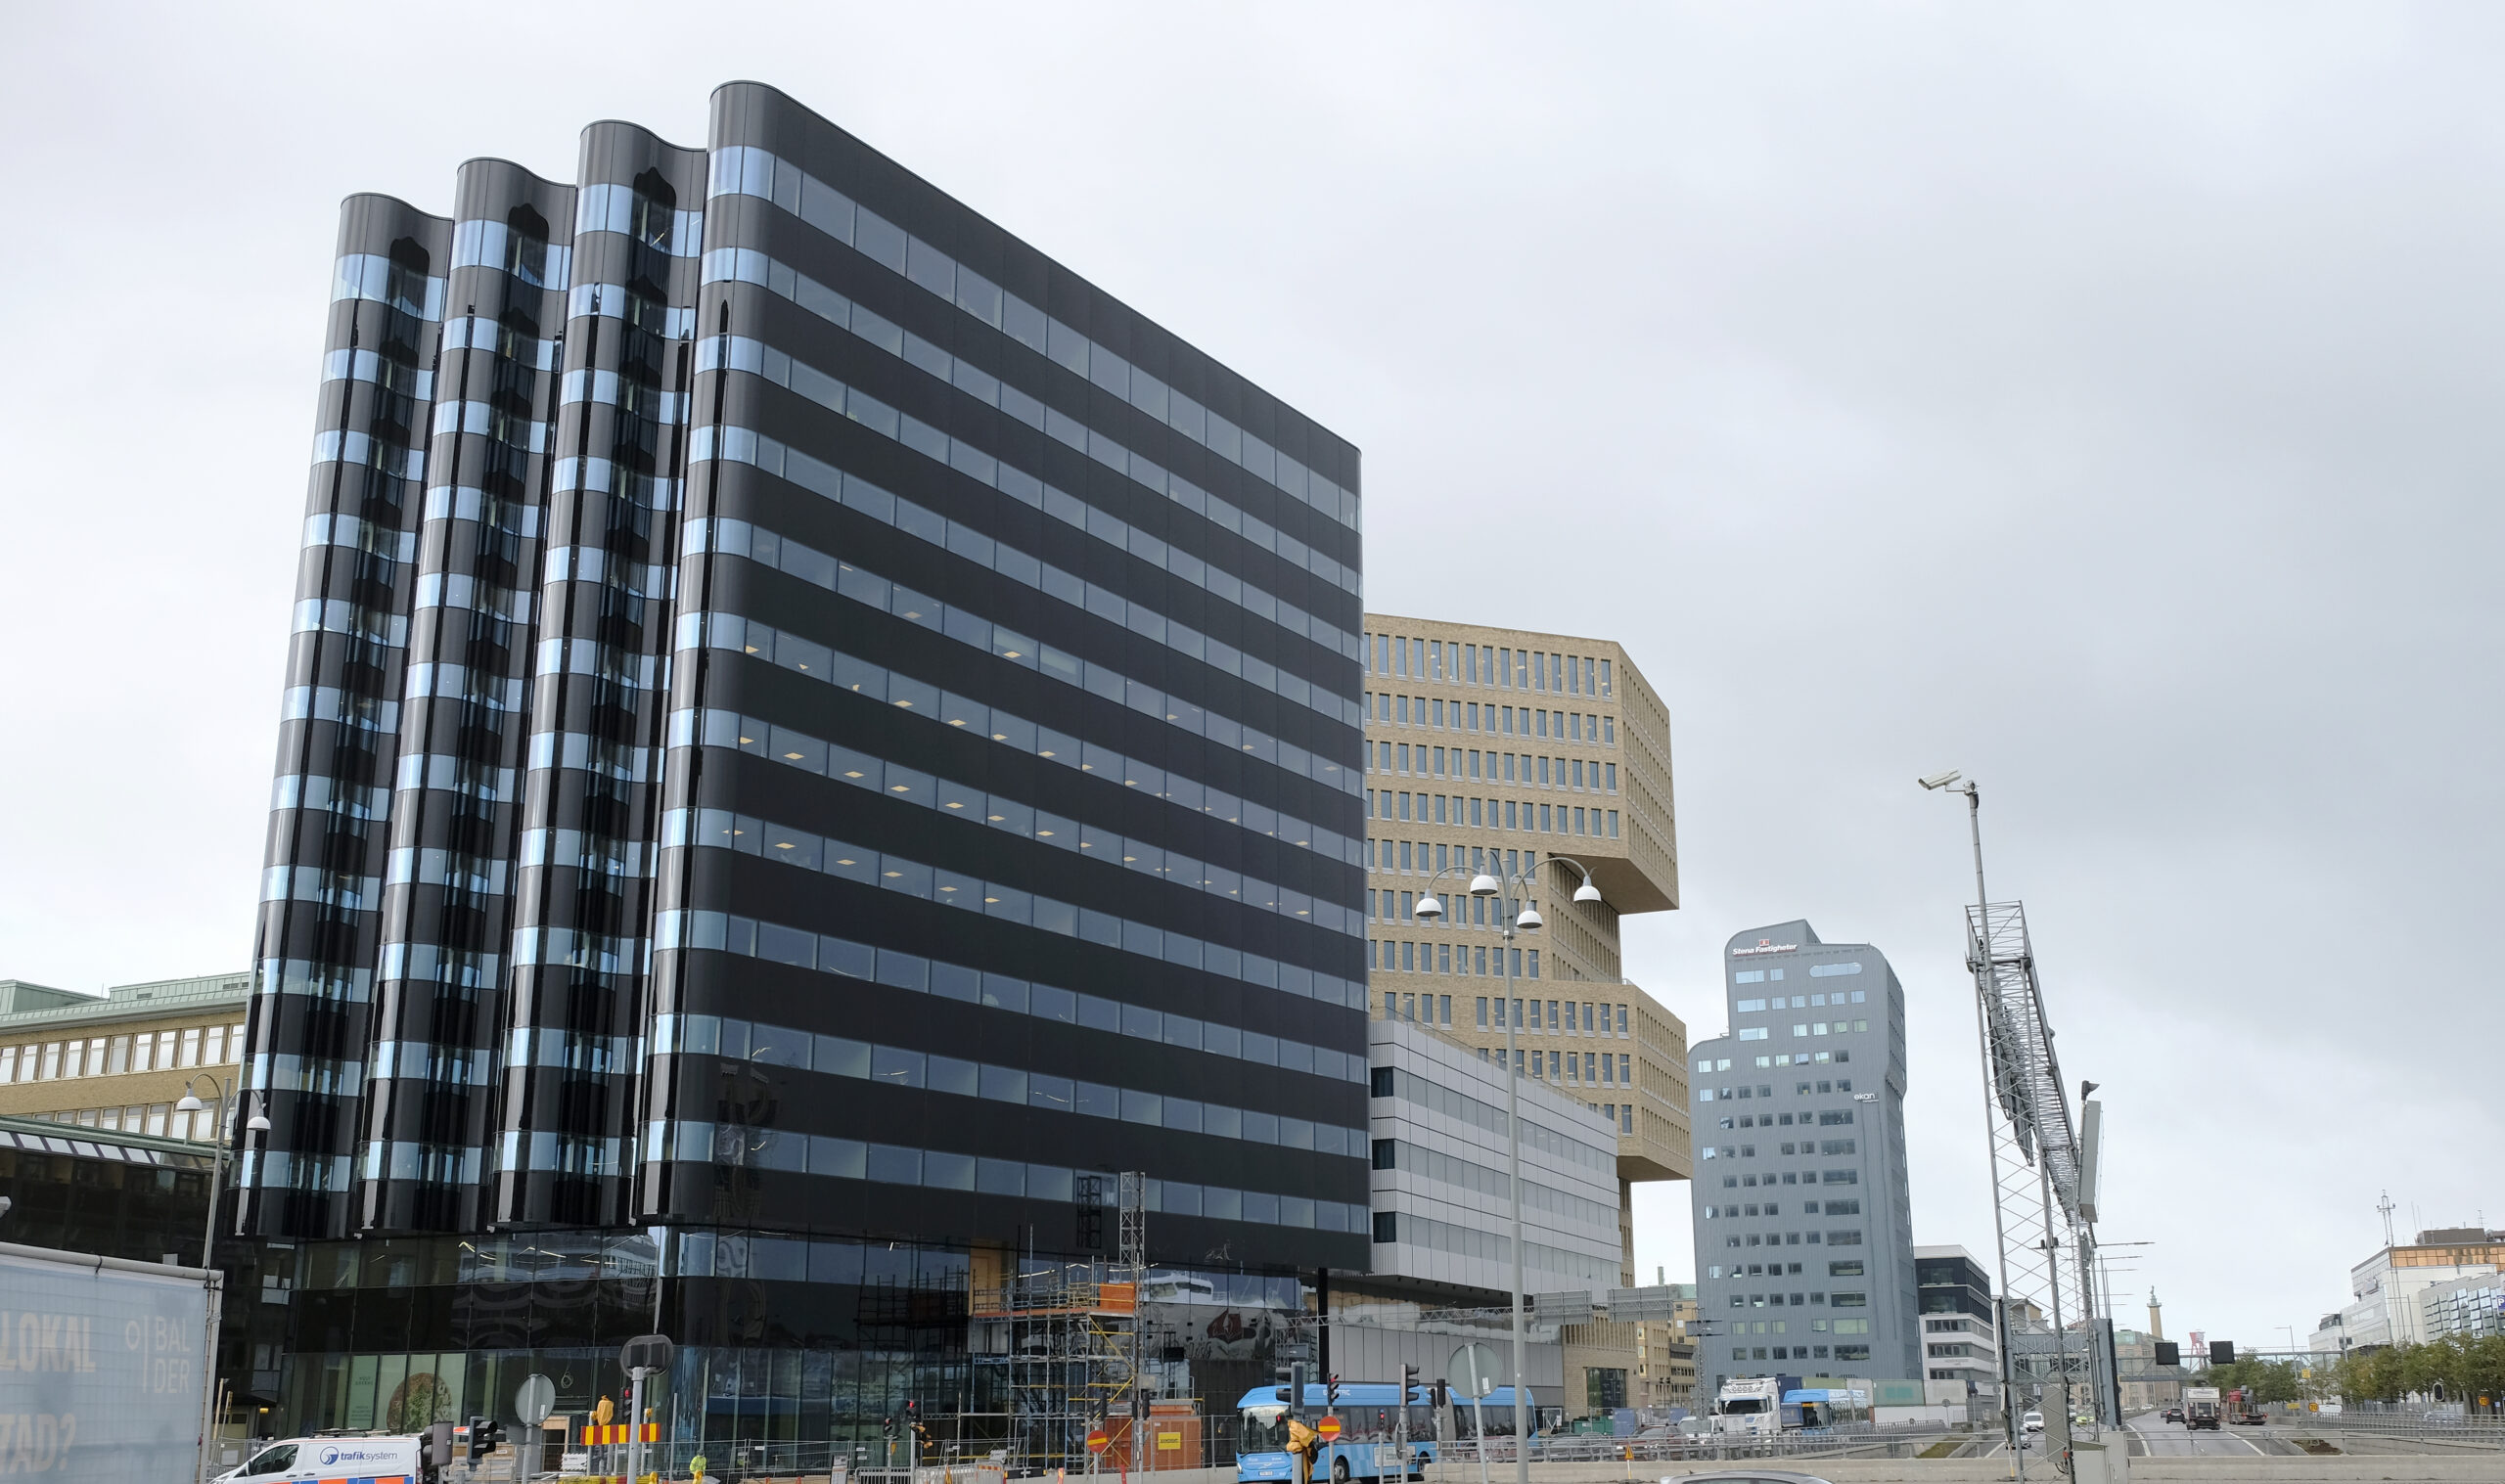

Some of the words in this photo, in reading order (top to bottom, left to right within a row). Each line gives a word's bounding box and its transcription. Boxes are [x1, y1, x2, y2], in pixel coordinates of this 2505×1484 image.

[1755, 944, 1798, 953] Fastigheter
[0, 1311, 96, 1373] LOKAL
[156, 1316, 191, 1353] BAL
[154, 1358, 191, 1394] DER
[341, 1451, 398, 1462] trafiksystem
